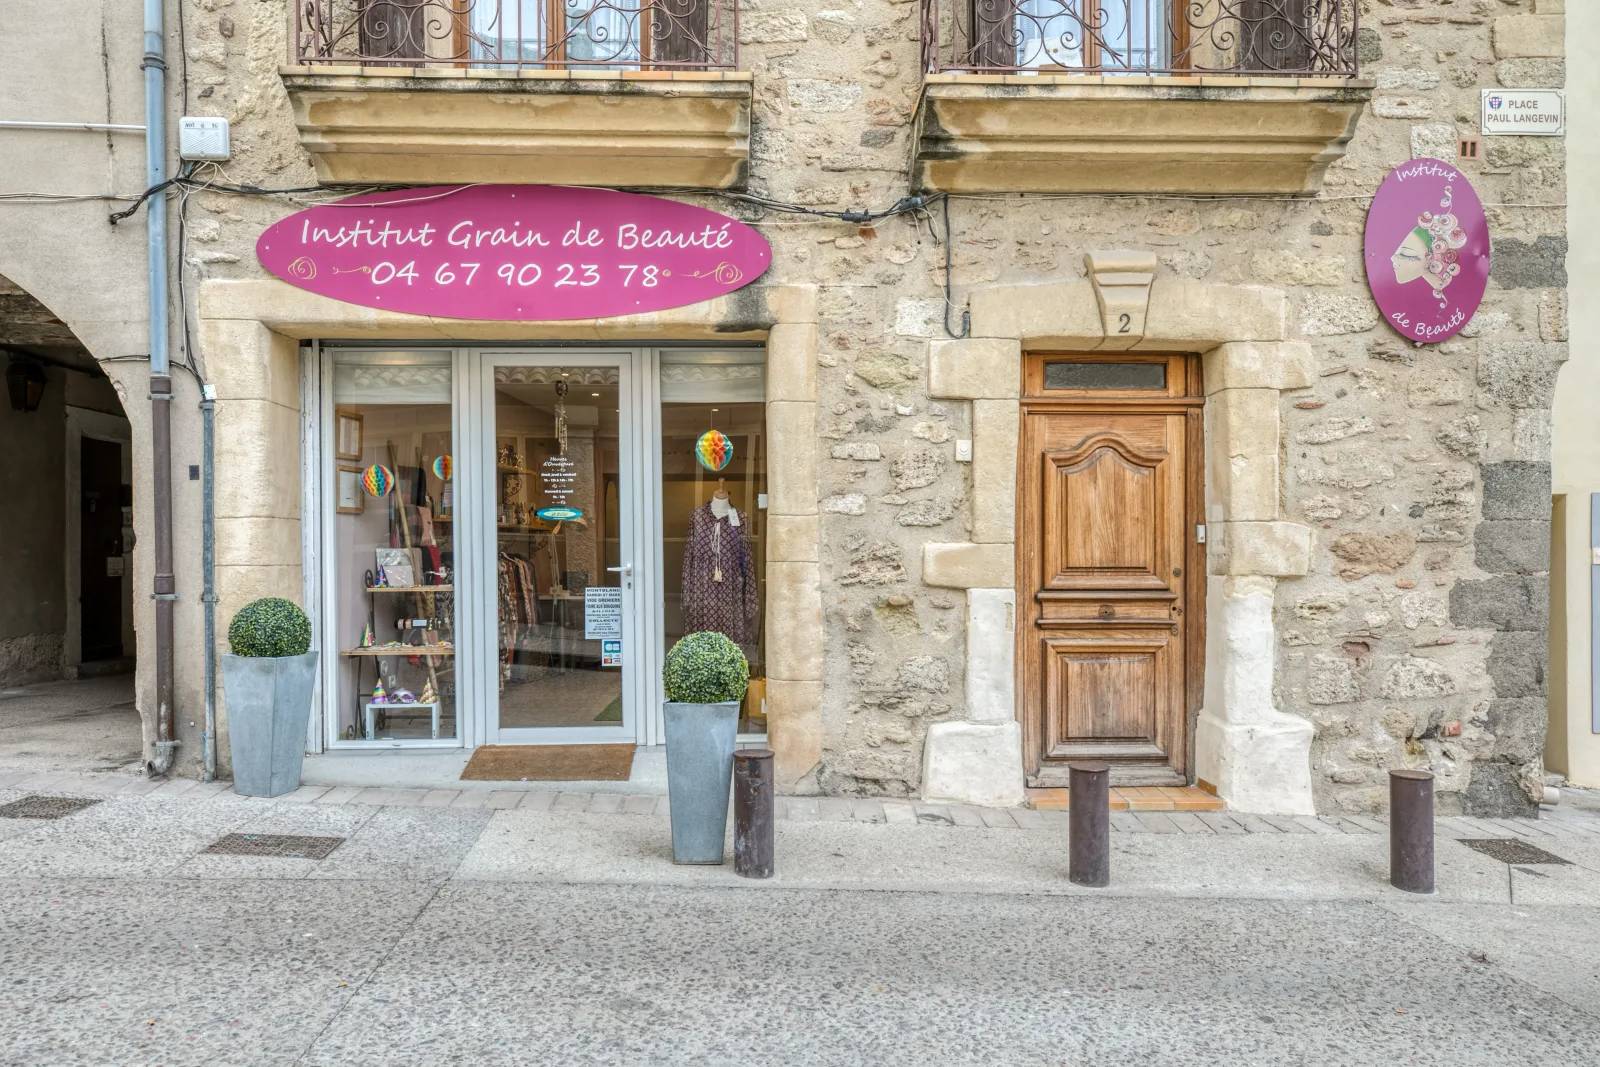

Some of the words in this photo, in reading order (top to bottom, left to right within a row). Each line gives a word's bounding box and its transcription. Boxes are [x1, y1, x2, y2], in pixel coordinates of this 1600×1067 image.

[1508, 100, 1538, 109] PLACE
[1487, 113, 1511, 123] PAUL
[1513, 113, 1559, 123] LANGEVIN
[1396, 162, 1457, 182] Institut
[301, 219, 436, 248] Institut
[447, 220, 550, 249] Grain
[562, 221, 604, 247] de
[617, 221, 733, 250] Beauté
[367, 260, 419, 286] 04
[434, 262, 481, 286] 67
[497, 263, 542, 287] 90
[554, 263, 601, 288] 23
[618, 264, 659, 288] 78
[1118, 313, 1131, 333] 2
[1392, 312, 1410, 328] de
[1415, 307, 1465, 336] Beauté
